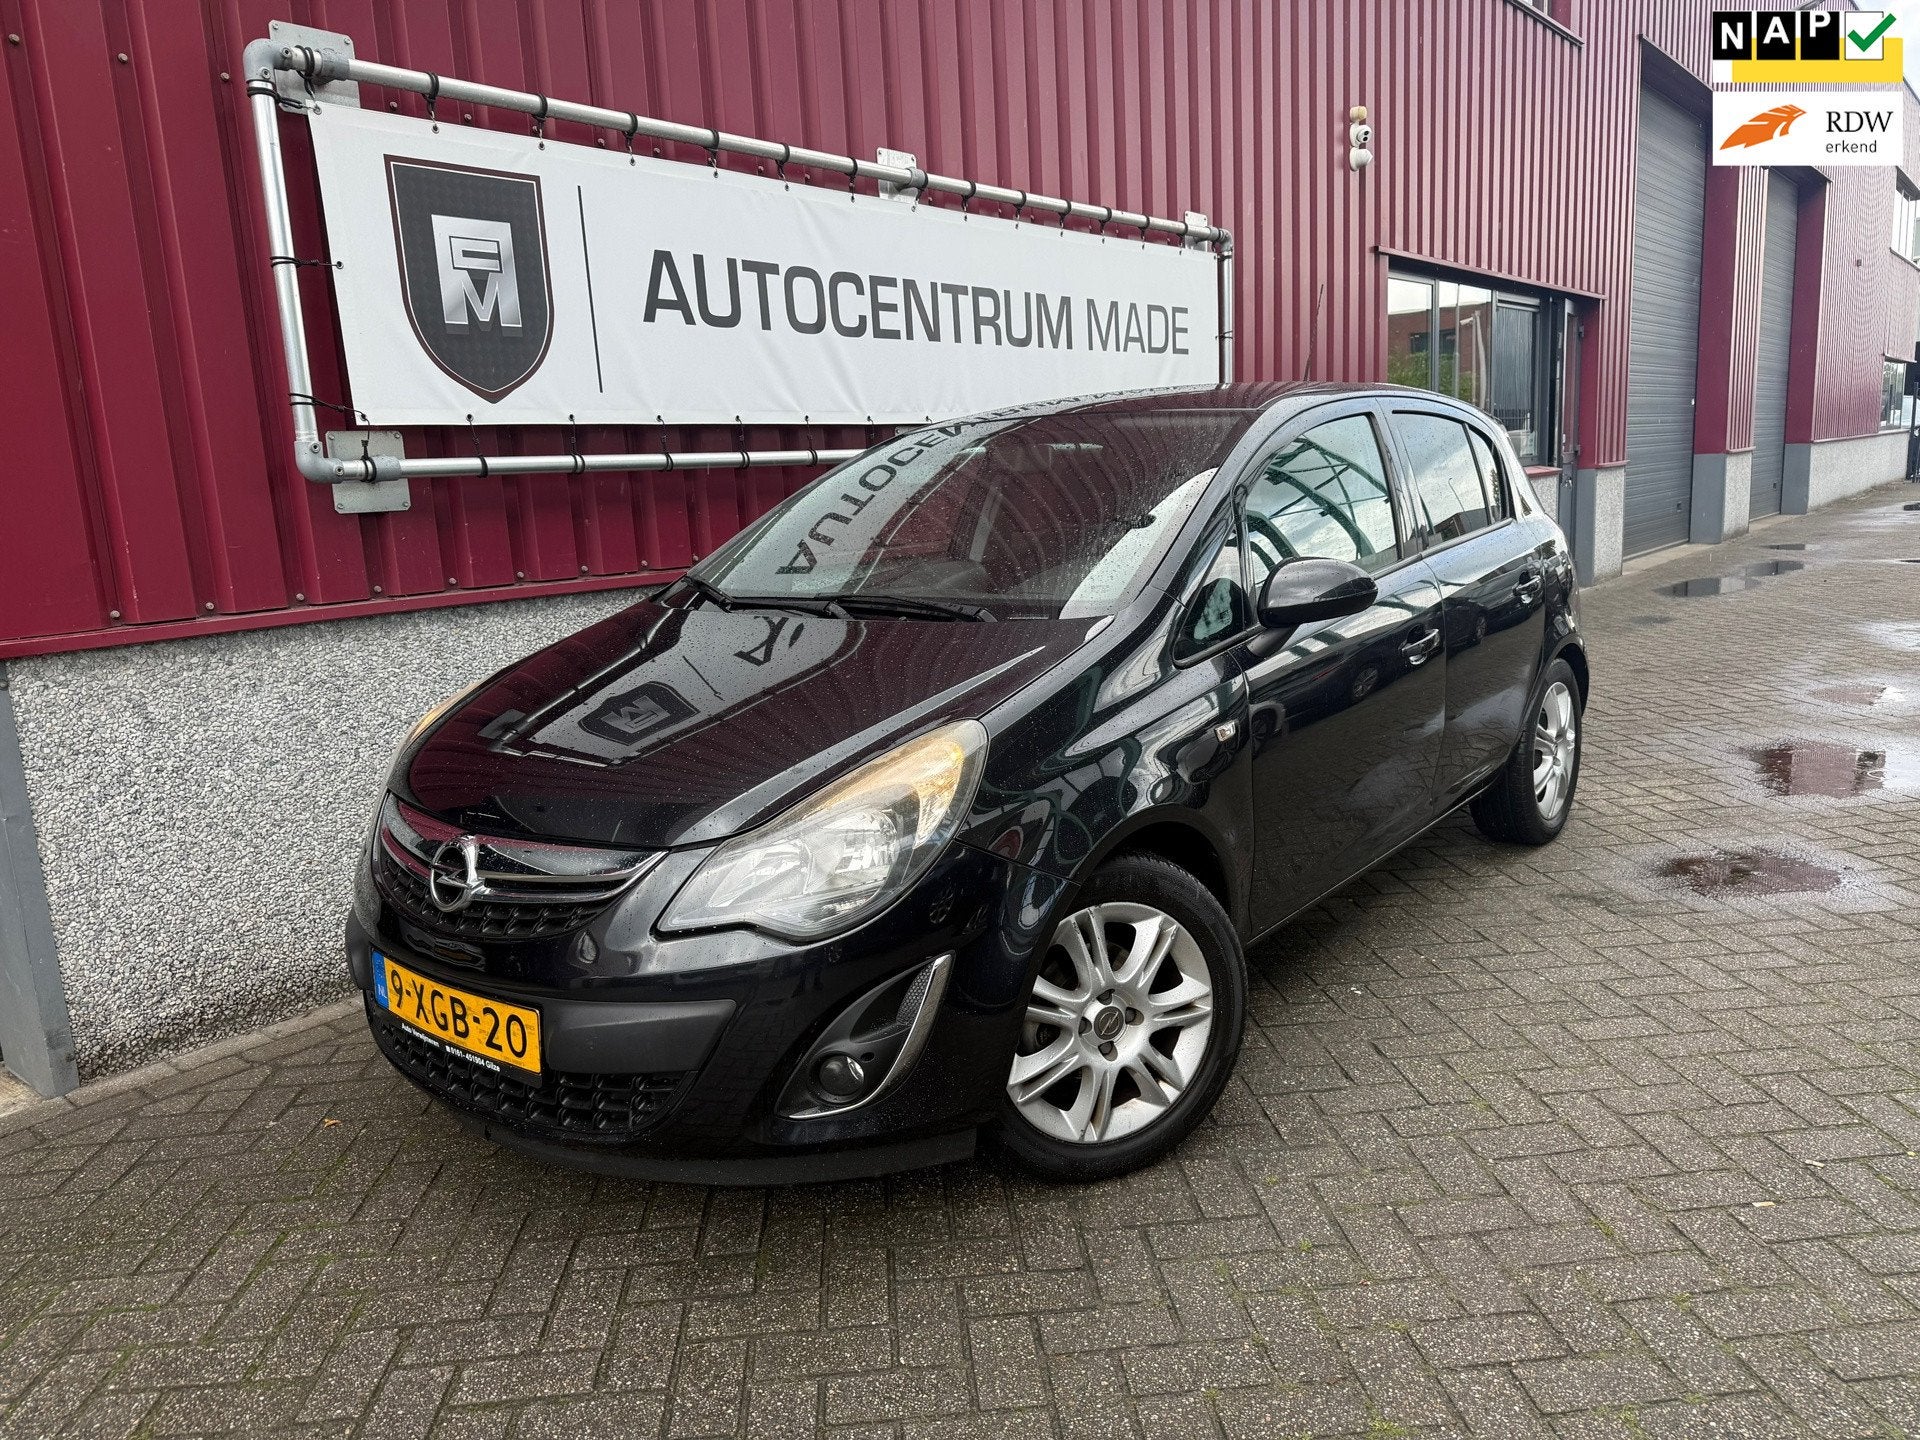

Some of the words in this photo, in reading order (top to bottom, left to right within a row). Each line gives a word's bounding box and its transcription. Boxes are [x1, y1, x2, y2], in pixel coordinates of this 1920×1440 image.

[643, 249, 1073, 350] AUTOCENTRUM
[1086, 298, 1189, 355] MADE
[377, 984, 387, 998] NL
[391, 969, 527, 1058] 9-XGB-20
